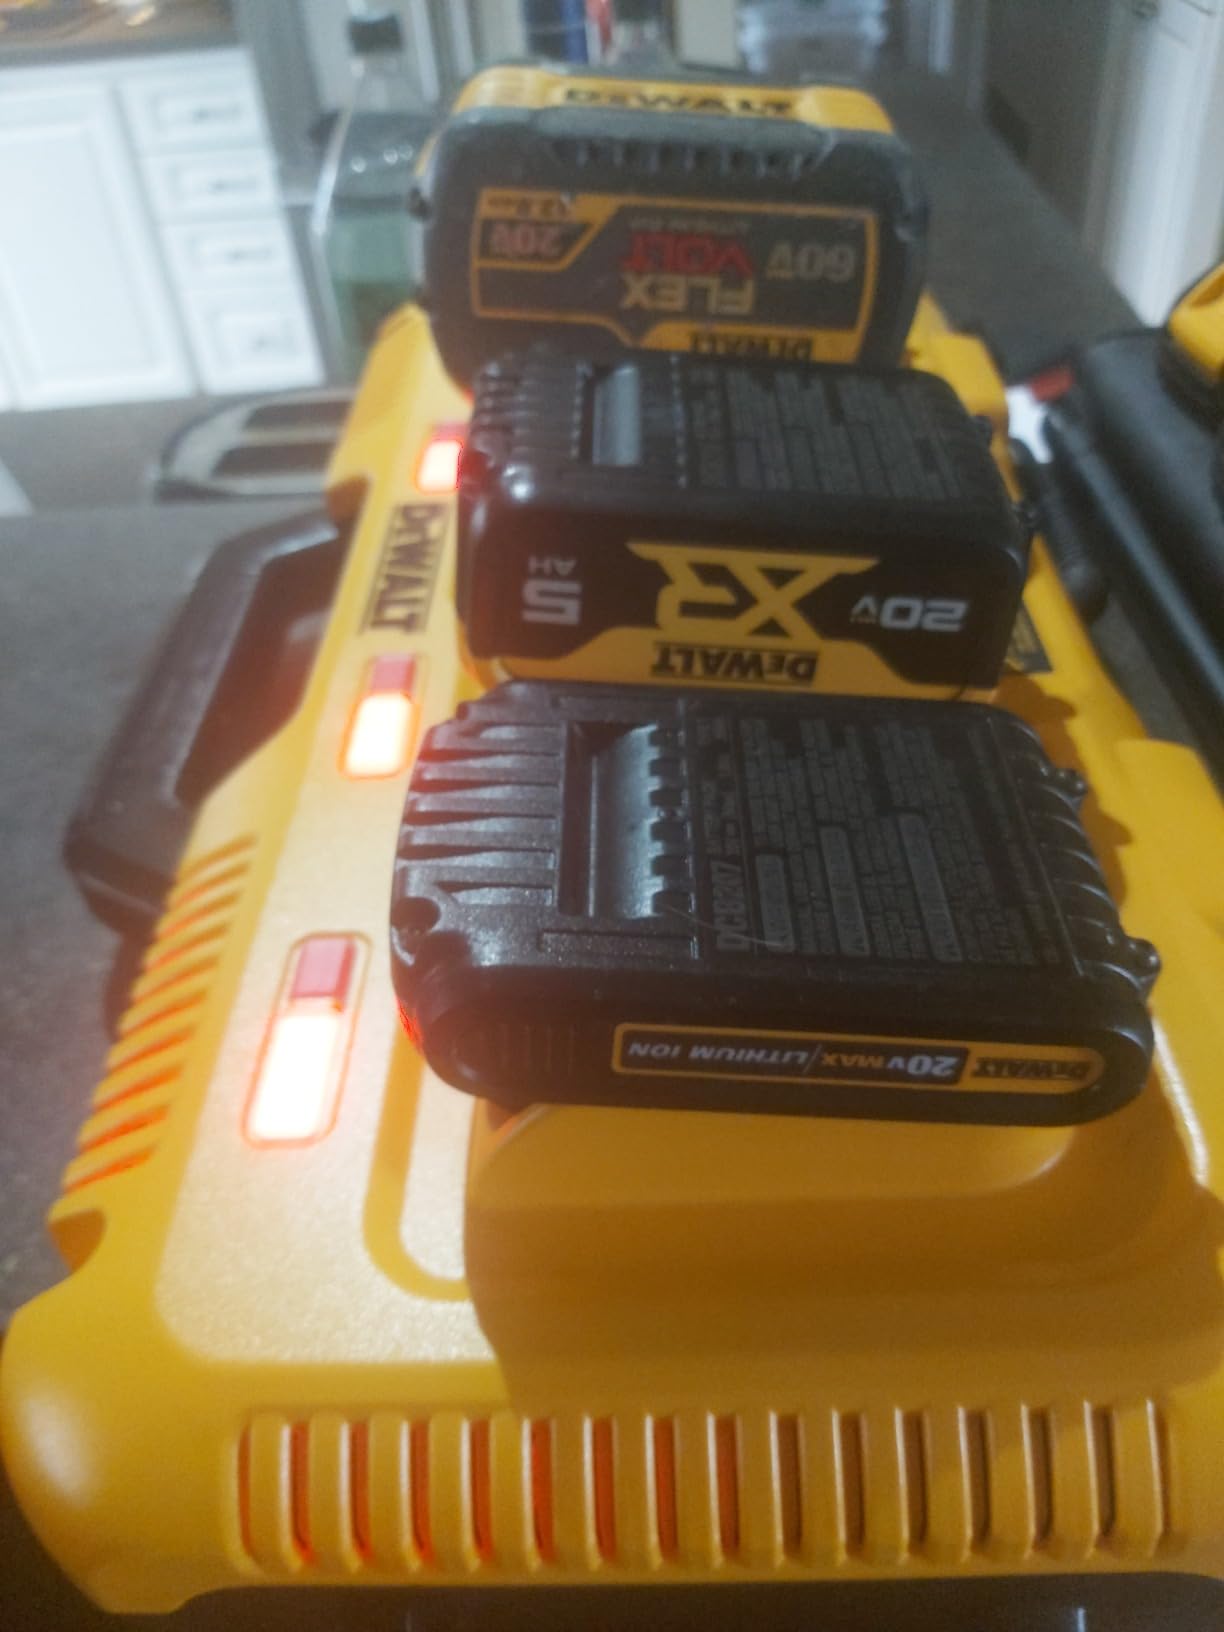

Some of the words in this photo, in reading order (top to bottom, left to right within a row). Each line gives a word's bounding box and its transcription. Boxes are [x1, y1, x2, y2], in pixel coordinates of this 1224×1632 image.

[623, 231, 754, 278] VOLT
[620, 272, 756, 315] FLEX
[521, 578, 582, 626] 5
[626, 541, 879, 641] XR
[627, 1040, 682, 1058] ION
